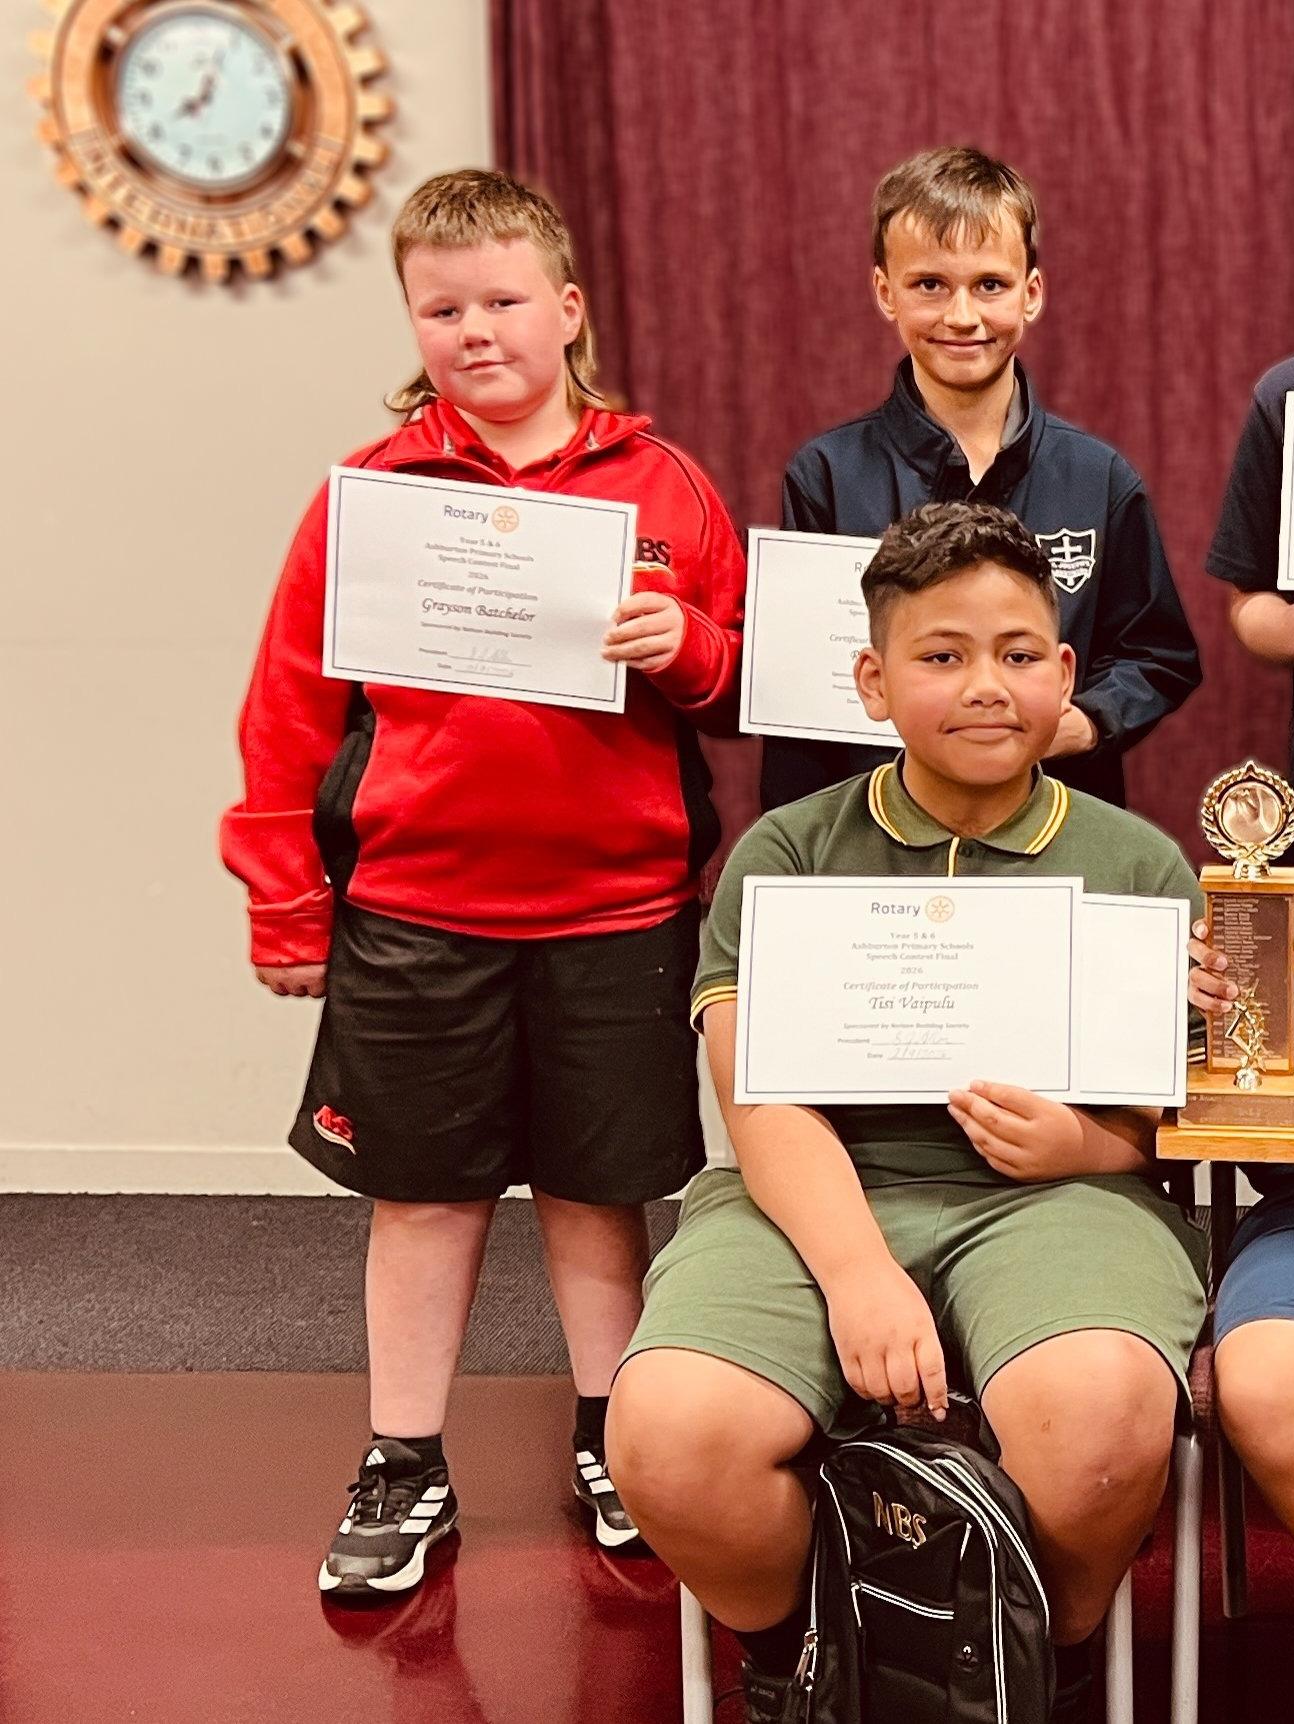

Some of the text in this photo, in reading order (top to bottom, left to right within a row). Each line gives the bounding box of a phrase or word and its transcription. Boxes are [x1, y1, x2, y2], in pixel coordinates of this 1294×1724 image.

[444, 504, 489, 524] Rotary
[418, 579, 465, 591] Certificate
[422, 598, 536, 622] Grayson Batchelor
[830, 634, 868, 643] Certificat
[871, 902, 920, 917] Rotary
[866, 953, 897, 961] Speech
[844, 982, 979, 991] Certificate of Participation
[899, 995, 955, 1014] Vaipulu
[873, 1491, 927, 1550] NBS
